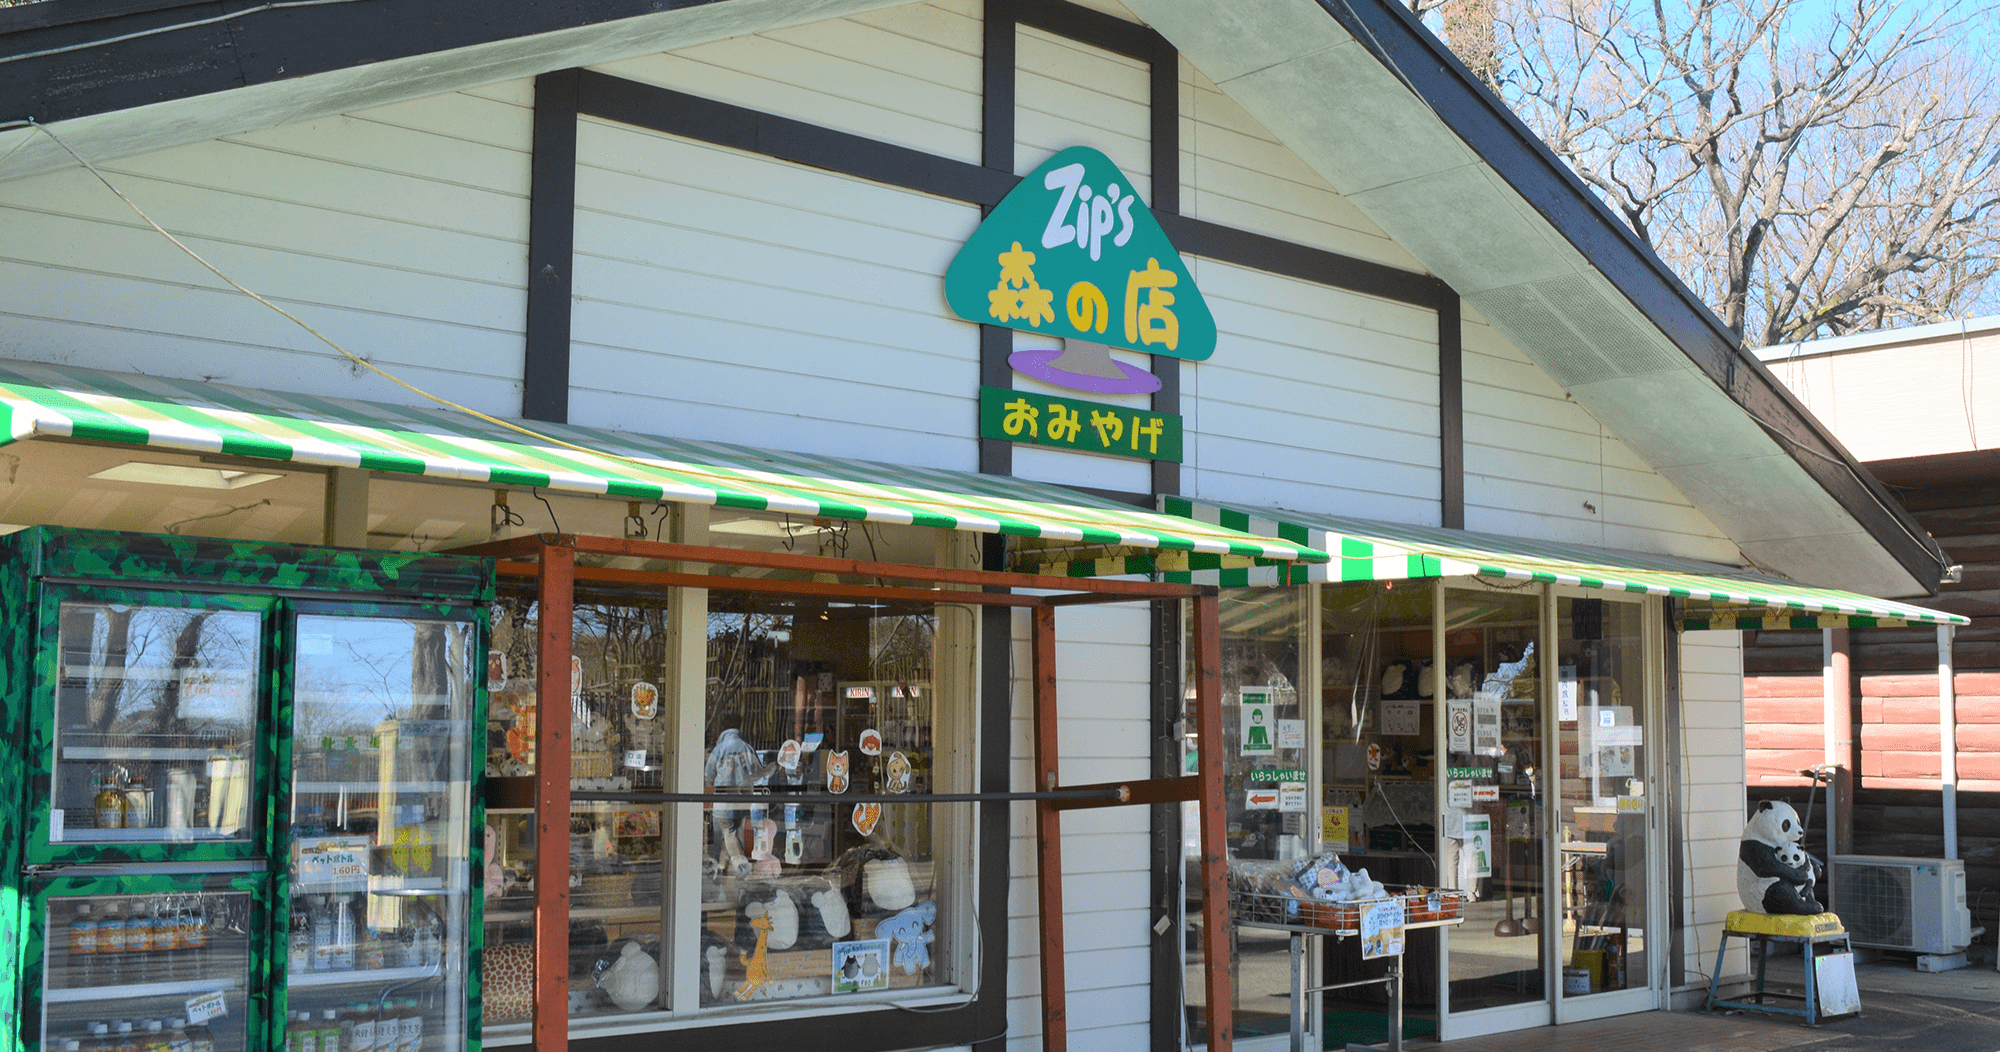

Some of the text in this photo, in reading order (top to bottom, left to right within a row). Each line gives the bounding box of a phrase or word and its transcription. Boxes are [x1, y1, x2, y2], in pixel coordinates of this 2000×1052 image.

[1041, 163, 1135, 262] Zip's
[988, 241, 1180, 351] 森の店
[1002, 397, 1165, 455] おみやげ
[1250, 770, 1306, 782] いらっしゃいませ
[1447, 768, 1493, 778] いらっしゃいませ
[311, 854, 354, 864] ペットボトル
[332, 865, 360, 875] 160円
